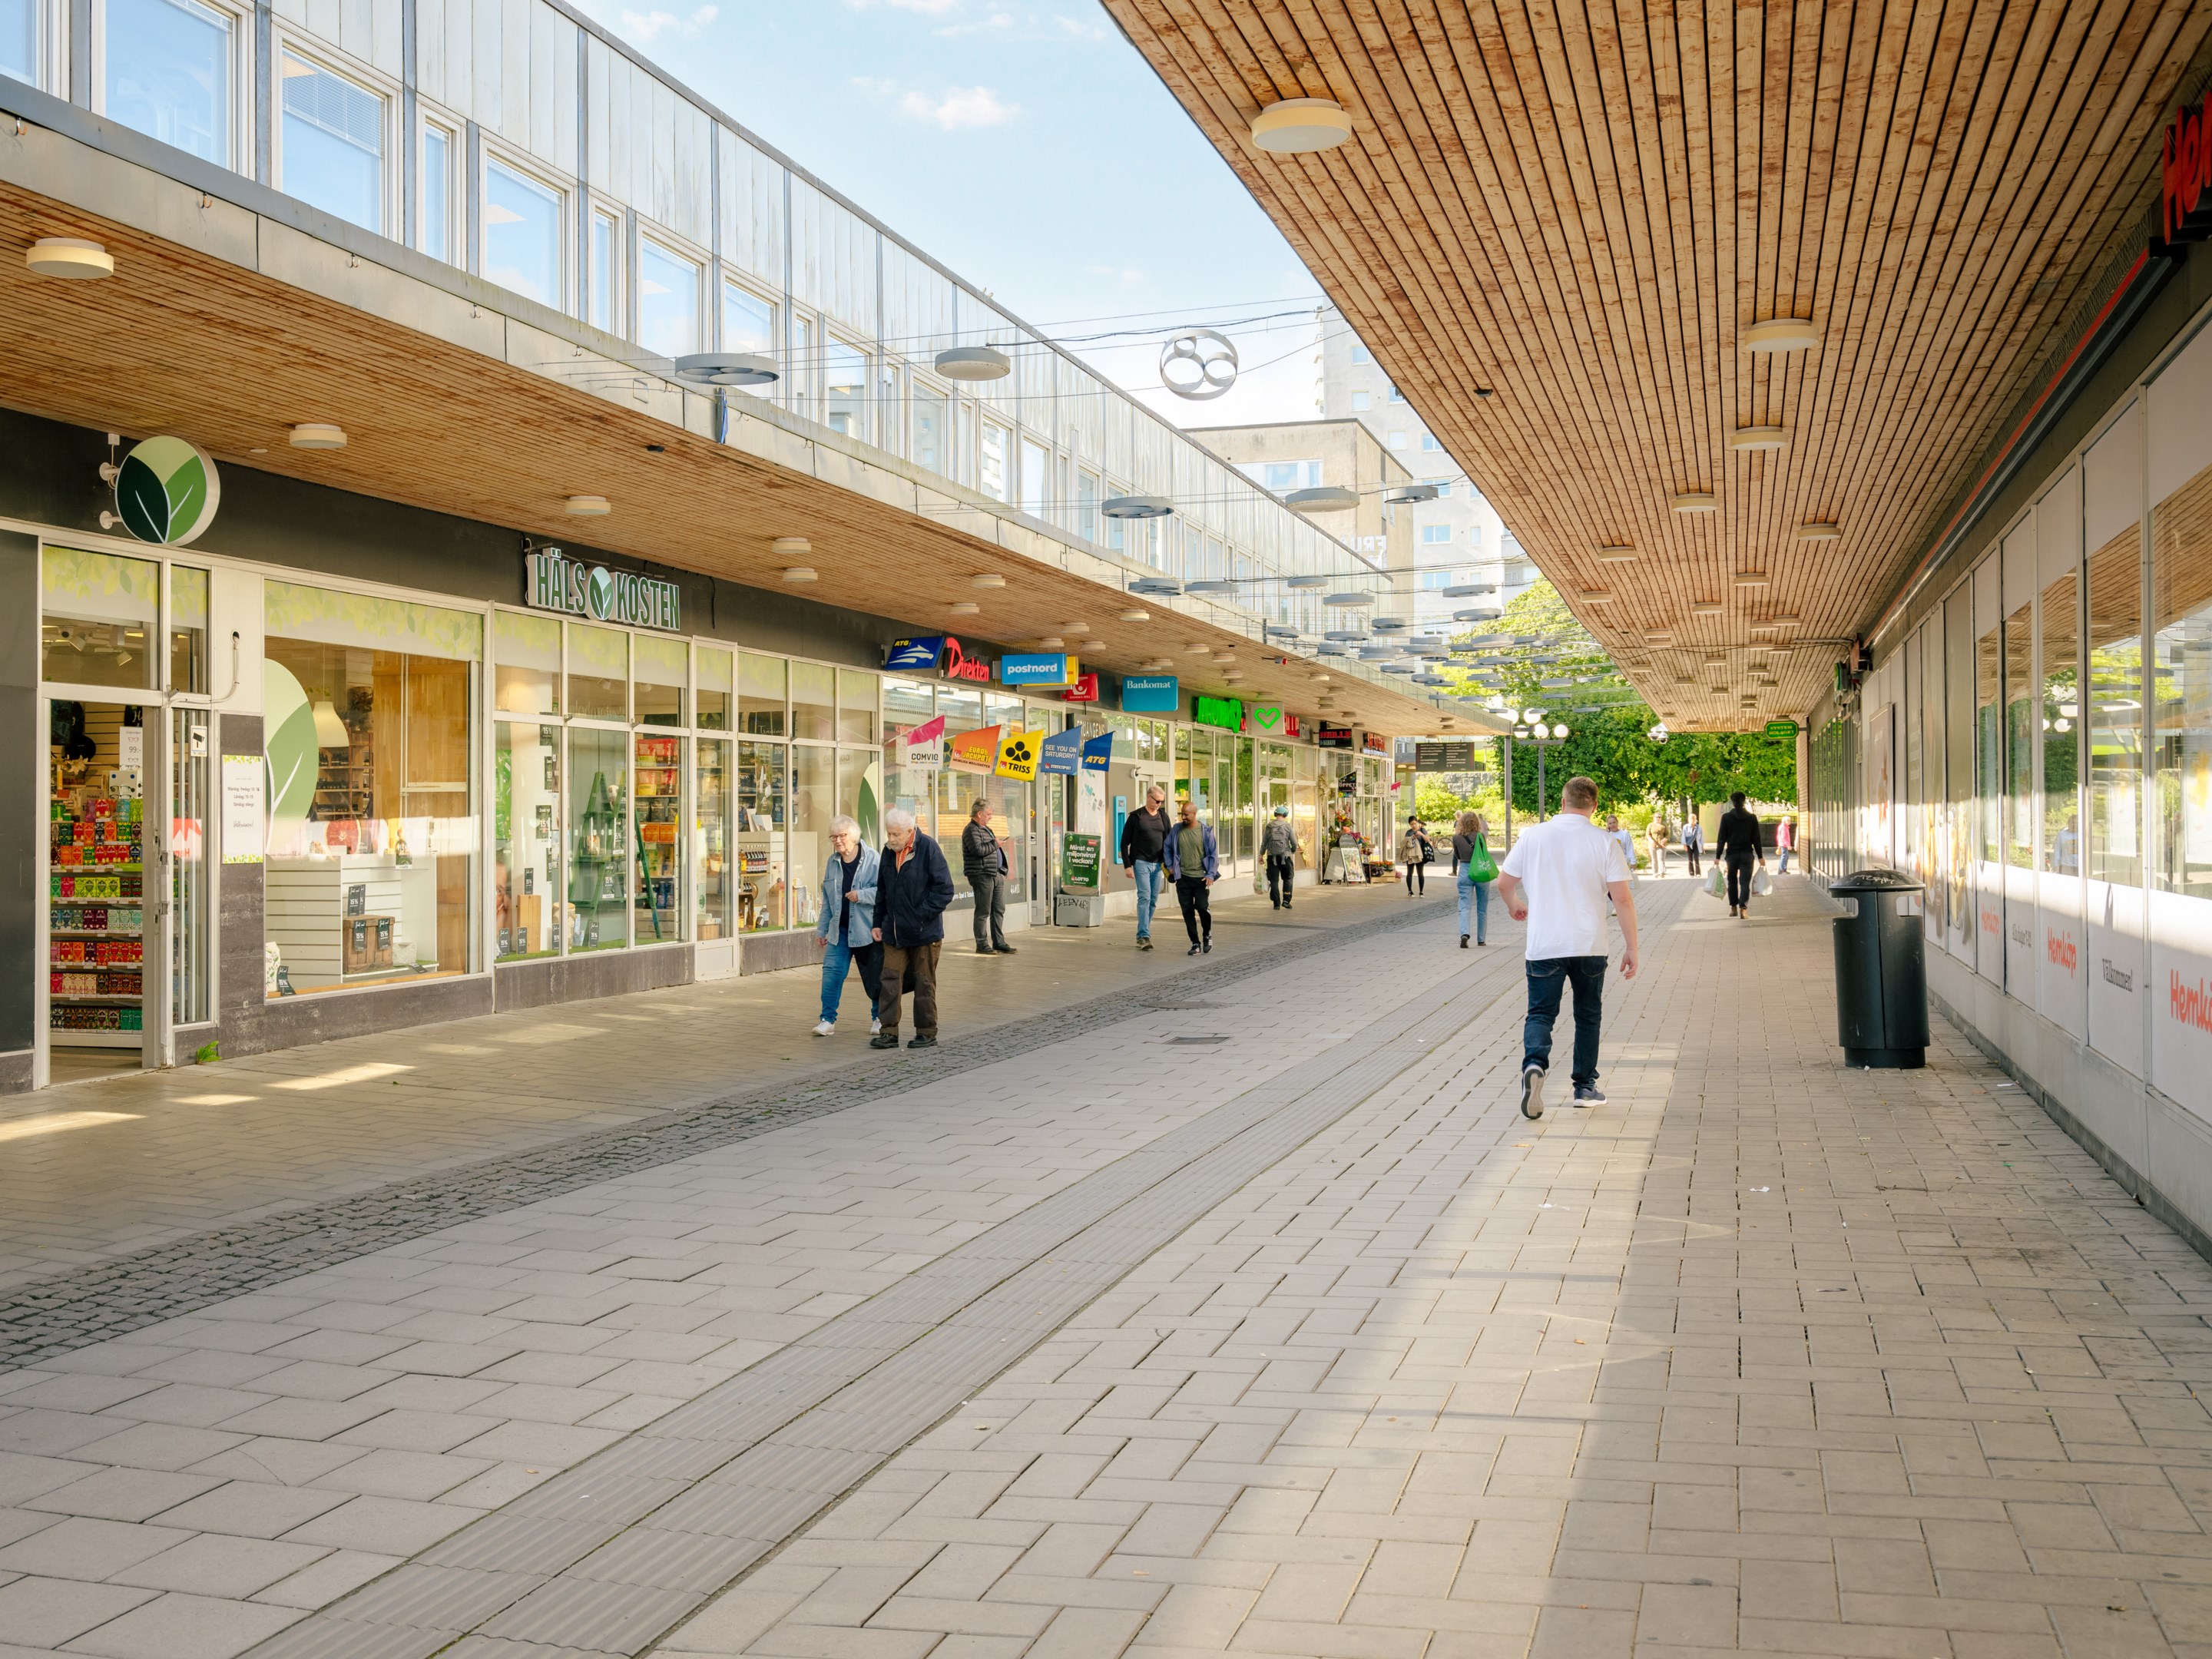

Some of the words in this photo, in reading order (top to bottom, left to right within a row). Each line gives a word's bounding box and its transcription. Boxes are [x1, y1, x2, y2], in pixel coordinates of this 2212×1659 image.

[535, 547, 586, 614] HÄLS
[615, 571, 680, 631] KOSTEN
[946, 637, 989, 683] Direkten
[1007, 663, 1058, 675] postnord
[1127, 680, 1171, 689] Bankomat
[969, 746, 985, 755] EURO
[911, 753, 939, 761] COMVIQ
[962, 752, 991, 763] JACKPOT
[1084, 755, 1108, 764] ATG
[1008, 762, 1031, 774] TRISS
[2048, 926, 2076, 979] Hemköp
[2102, 958, 2133, 993] Välkommen!
